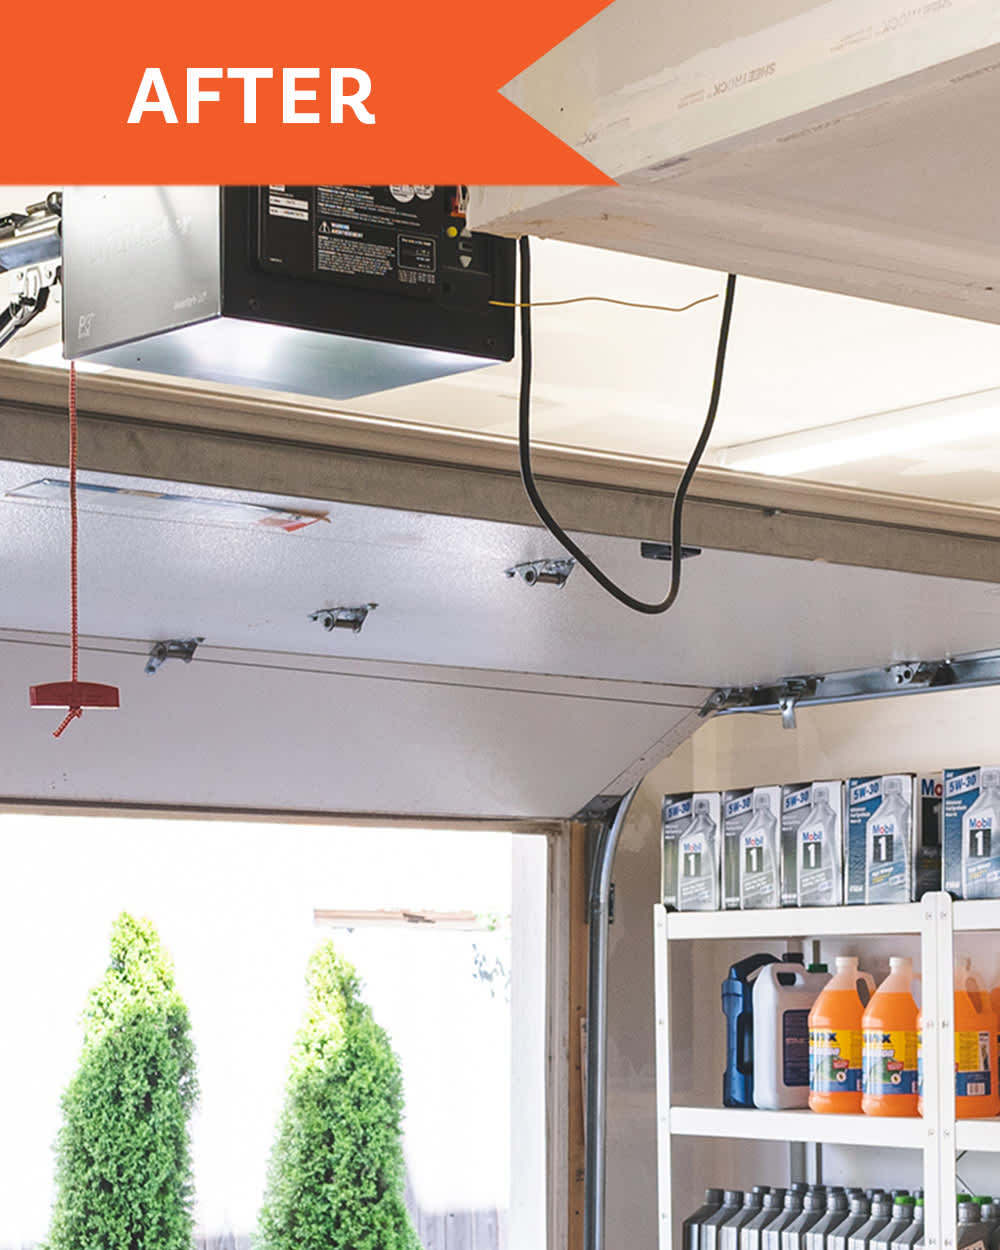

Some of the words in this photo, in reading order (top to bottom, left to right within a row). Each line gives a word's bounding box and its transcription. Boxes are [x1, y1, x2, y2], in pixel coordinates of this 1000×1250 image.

[853, 782, 880, 800] 5W-30
[949, 774, 976, 793] 5W-30
[728, 797, 751, 814] 5W-30
[785, 790, 809, 808] 5W-30
[668, 801, 691, 818] 5W-30
[872, 823, 894, 834] Mobil
[969, 817, 992, 828] Mobil
[744, 836, 763, 846] Mobil
[802, 831, 823, 841] Mobil
[975, 831, 983, 856] 1
[683, 842, 702, 852] Mobil
[807, 844, 815, 868] 1
[878, 836, 886, 861] 1
[688, 854, 695, 876] 1
[750, 848, 757, 872] 1
